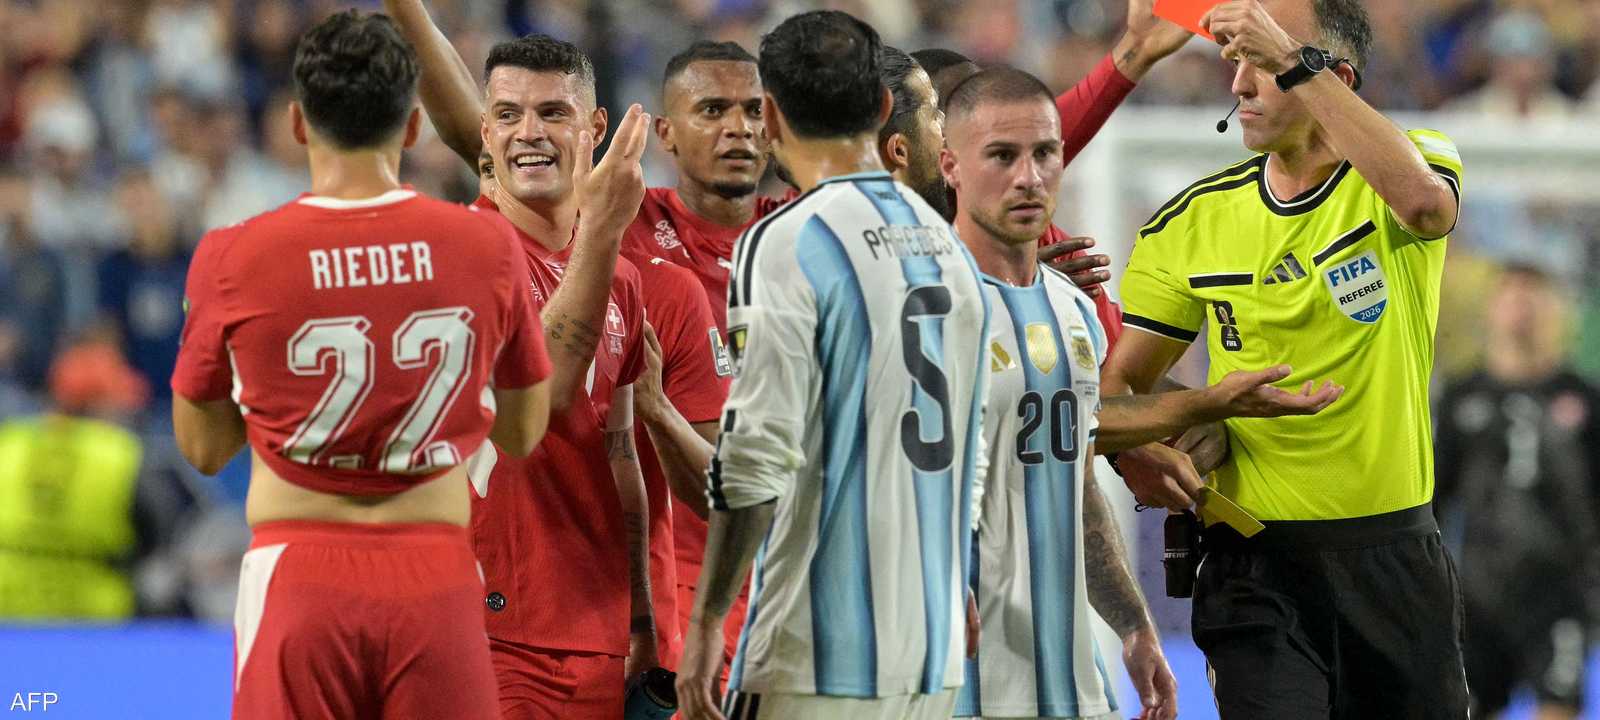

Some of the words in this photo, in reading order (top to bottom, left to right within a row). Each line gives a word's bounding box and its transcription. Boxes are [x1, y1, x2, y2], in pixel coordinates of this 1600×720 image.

[309, 241, 434, 289] RIEDER
[1327, 256, 1377, 287] FIFA
[1338, 280, 1385, 305] REFEREE
[1361, 305, 1381, 320] 2026
[282, 306, 475, 472] 22
[1016, 388, 1079, 465] 20
